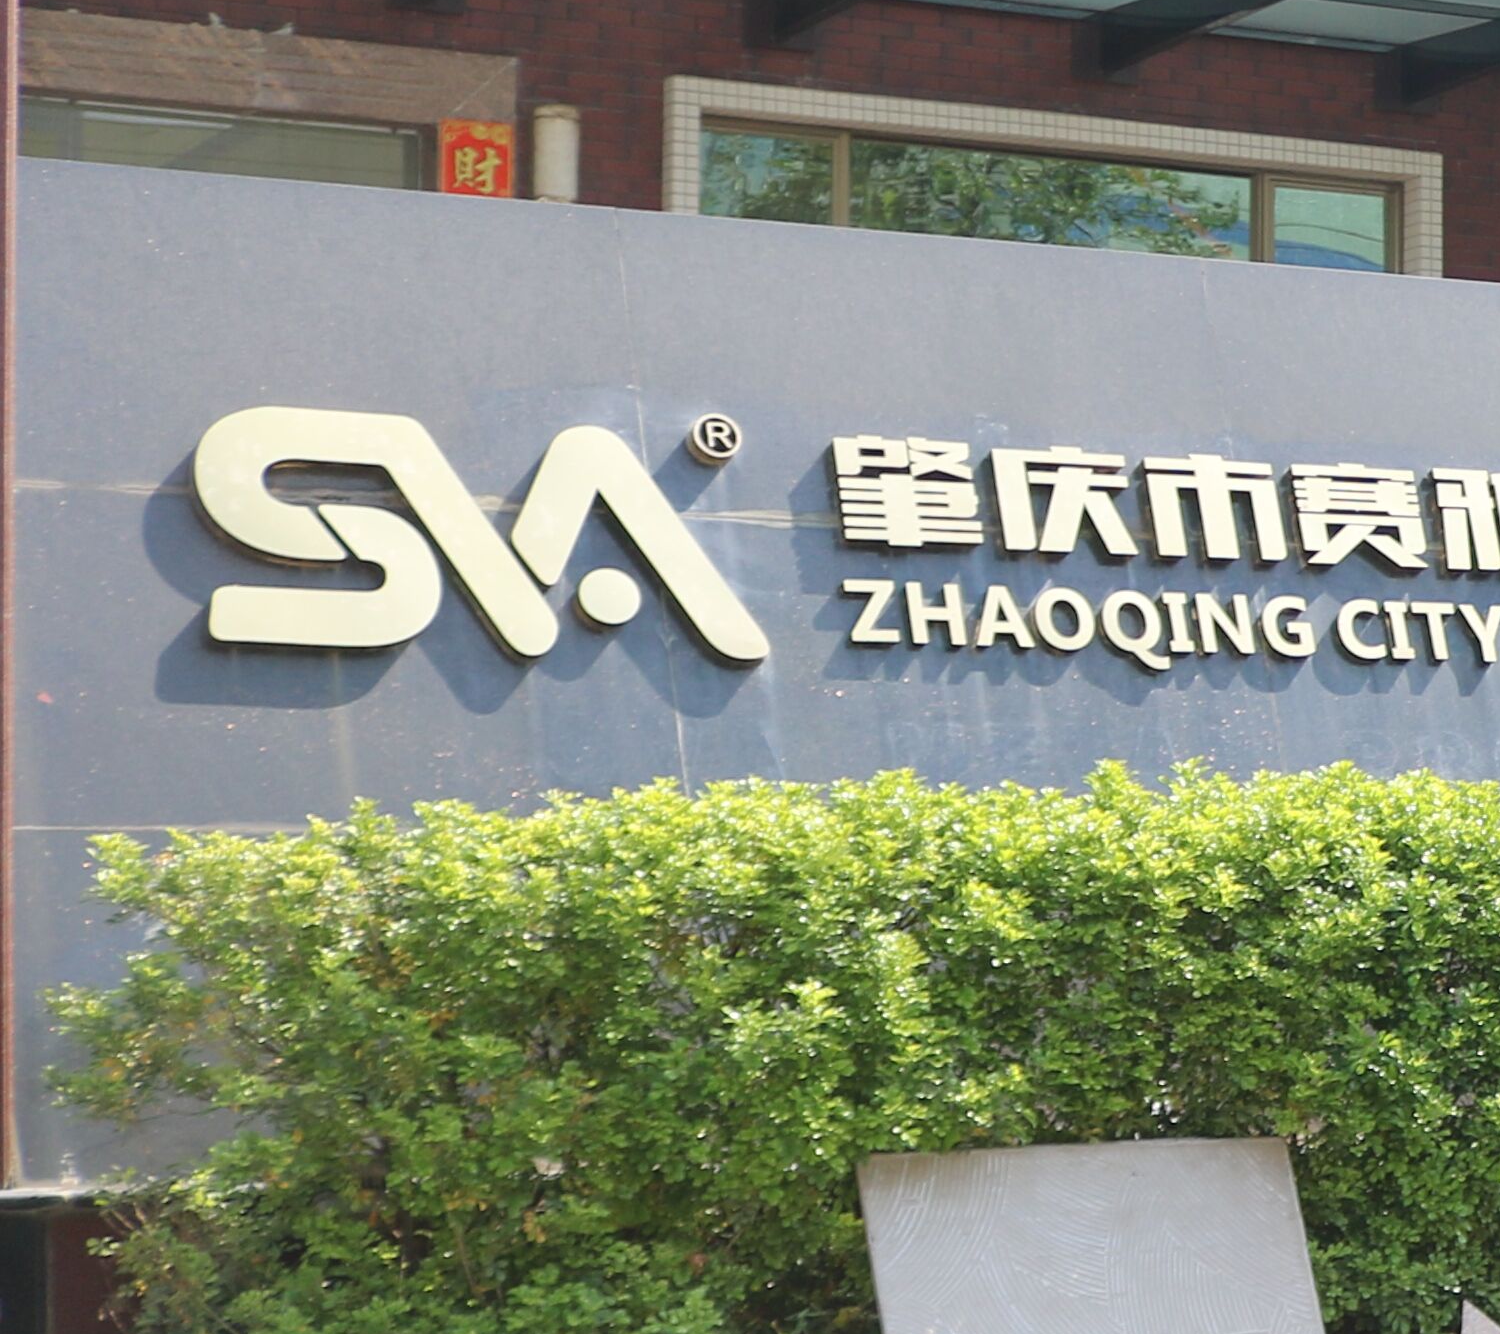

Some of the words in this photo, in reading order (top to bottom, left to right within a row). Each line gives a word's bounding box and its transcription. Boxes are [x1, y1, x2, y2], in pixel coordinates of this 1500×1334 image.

[452, 146, 502, 194] 財
[193, 404, 770, 664] SVA
[840, 576, 1318, 670] ZHAOQING
